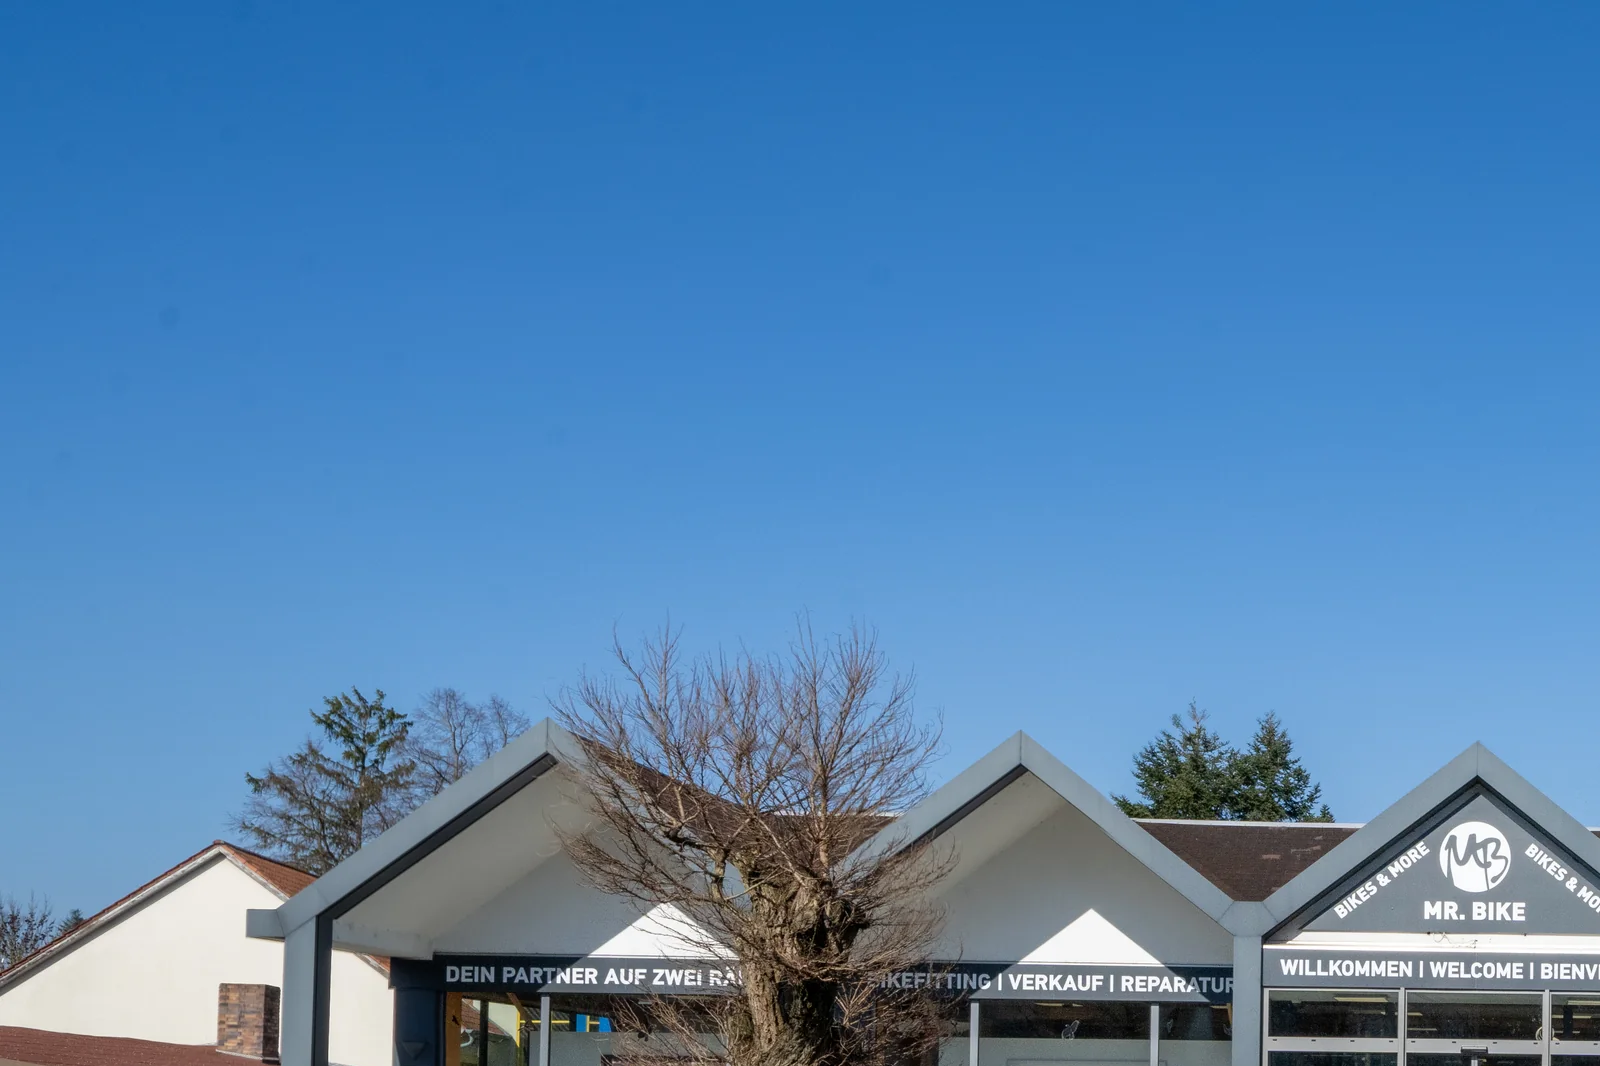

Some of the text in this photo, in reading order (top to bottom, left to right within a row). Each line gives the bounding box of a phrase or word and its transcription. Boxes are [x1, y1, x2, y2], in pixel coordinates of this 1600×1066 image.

[1524, 842, 1568, 881] BIKES
[1565, 876, 1579, 893] &
[1333, 840, 1430, 919] BIKES & MORE
[1424, 901, 1526, 921] MR. BIKE
[446, 966, 495, 983] DEIN
[502, 966, 598, 985] PARTNER
[604, 968, 647, 985] AUF
[652, 968, 702, 986] ZWEI
[1280, 958, 1413, 978] WILLKOMMEN
[1430, 960, 1523, 980] WELCOME
[1009, 974, 1103, 992] VERKAUF
